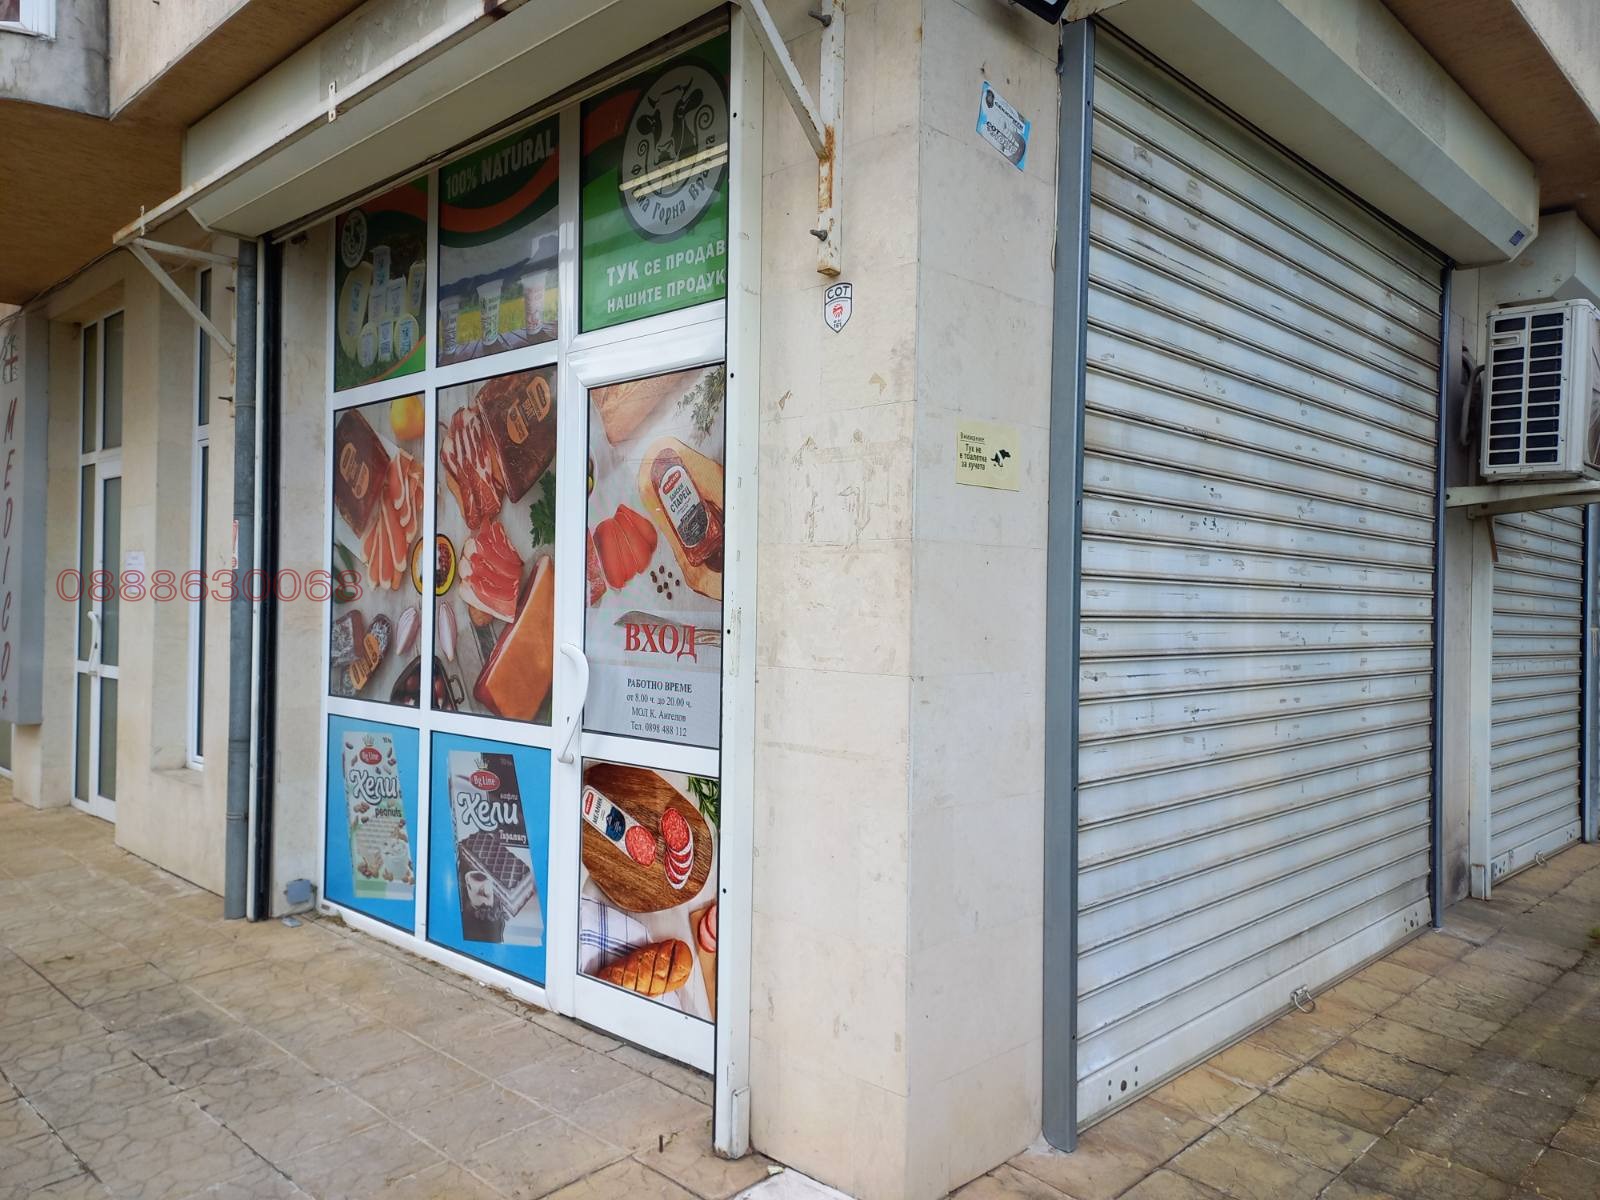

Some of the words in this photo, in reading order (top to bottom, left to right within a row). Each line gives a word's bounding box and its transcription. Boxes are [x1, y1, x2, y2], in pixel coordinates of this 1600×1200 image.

[446, 166, 477, 200] 100%
[480, 129, 555, 184] NATURAL
[606, 260, 639, 287] ТУК
[607, 286, 662, 313] НАШИТЕ
[670, 487, 692, 513] СТАРЕЦ
[3, 397, 17, 682] MEDICO
[624, 623, 698, 664] ВХОД
[627, 678, 663, 691] РАБОТНО
[664, 683, 693, 693] ВРЕМЕ
[662, 724, 674, 735] 488
[375, 806, 402, 818] peanuts
